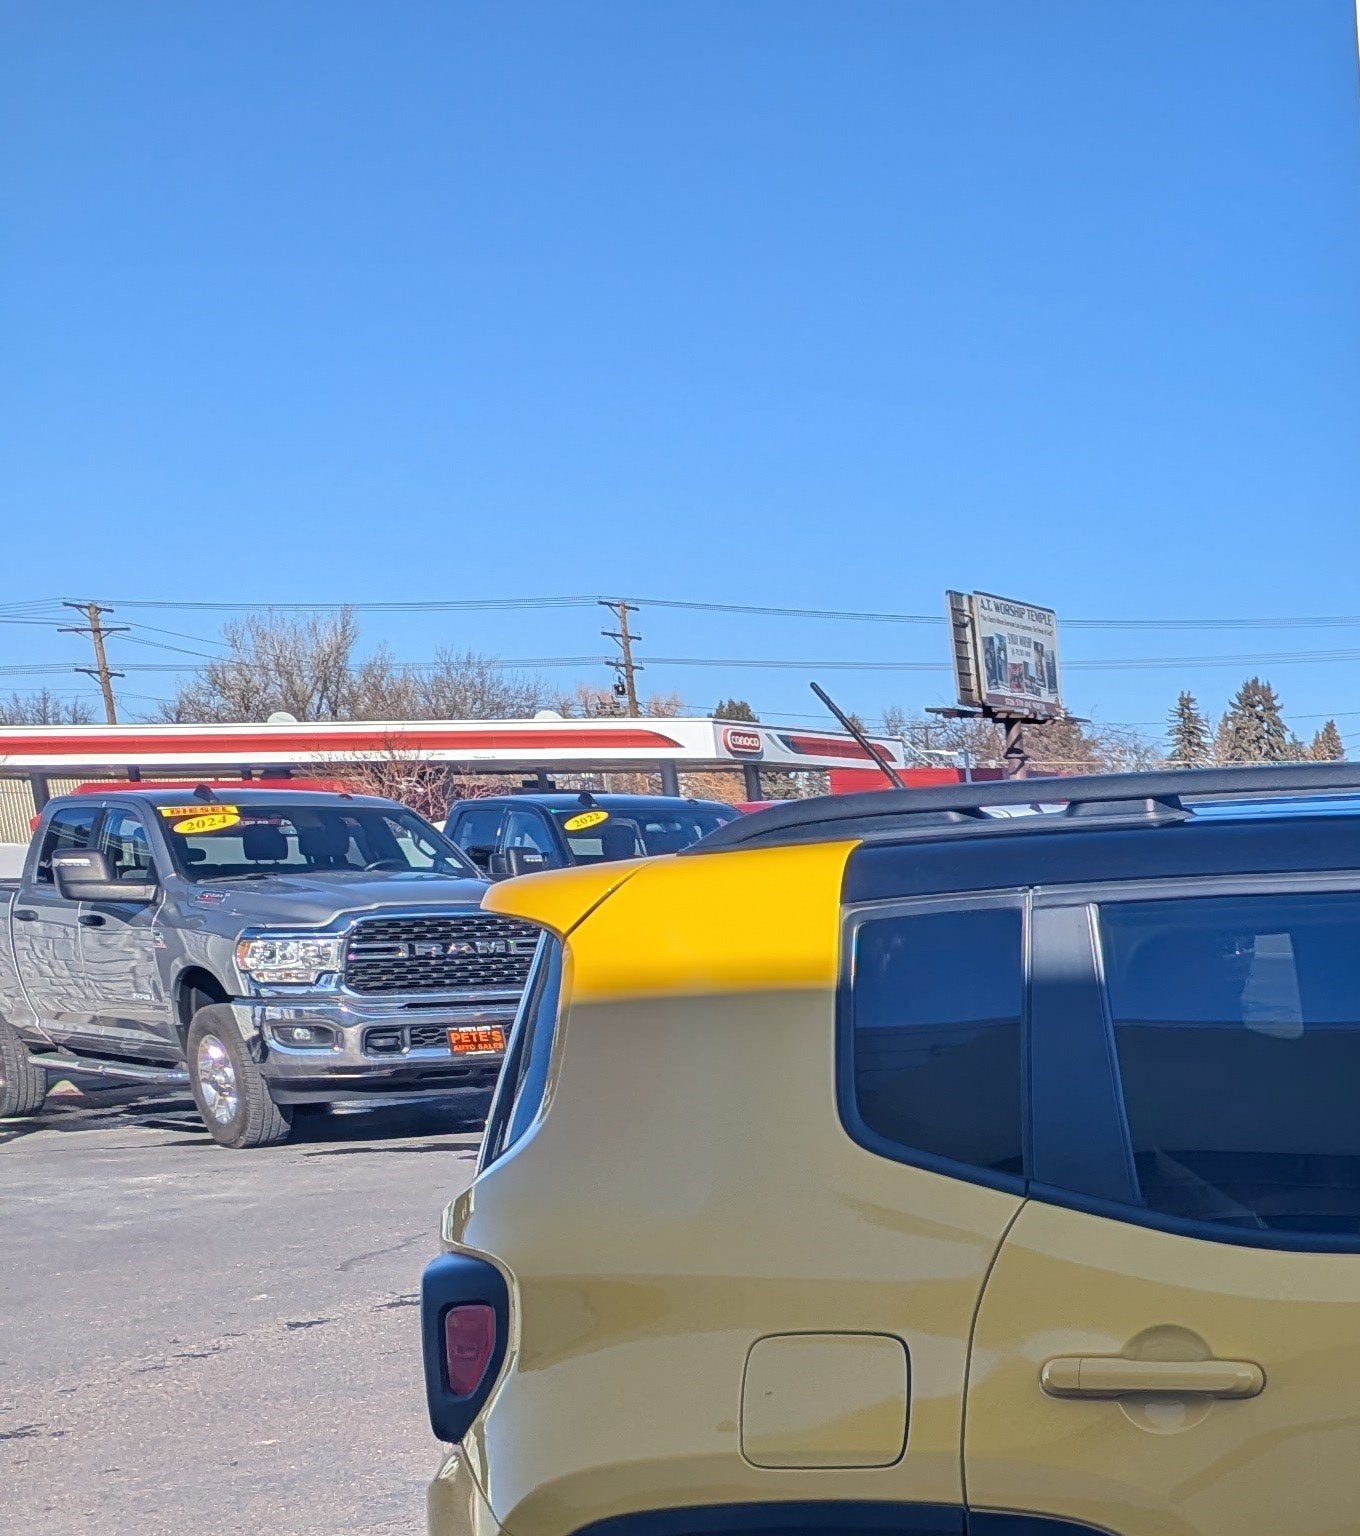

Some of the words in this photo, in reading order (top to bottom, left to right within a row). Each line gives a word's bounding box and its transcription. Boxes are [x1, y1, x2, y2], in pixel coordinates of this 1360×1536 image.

[994, 602, 1025, 619] WORSHIP
[1027, 609, 1053, 626] TEMPLE
[186, 815, 227, 832] 2024
[573, 813, 602, 828] 2022
[450, 1030, 502, 1044] PETE'S
[453, 1043, 476, 1052] AUTO
[478, 1042, 504, 1050] SALES
